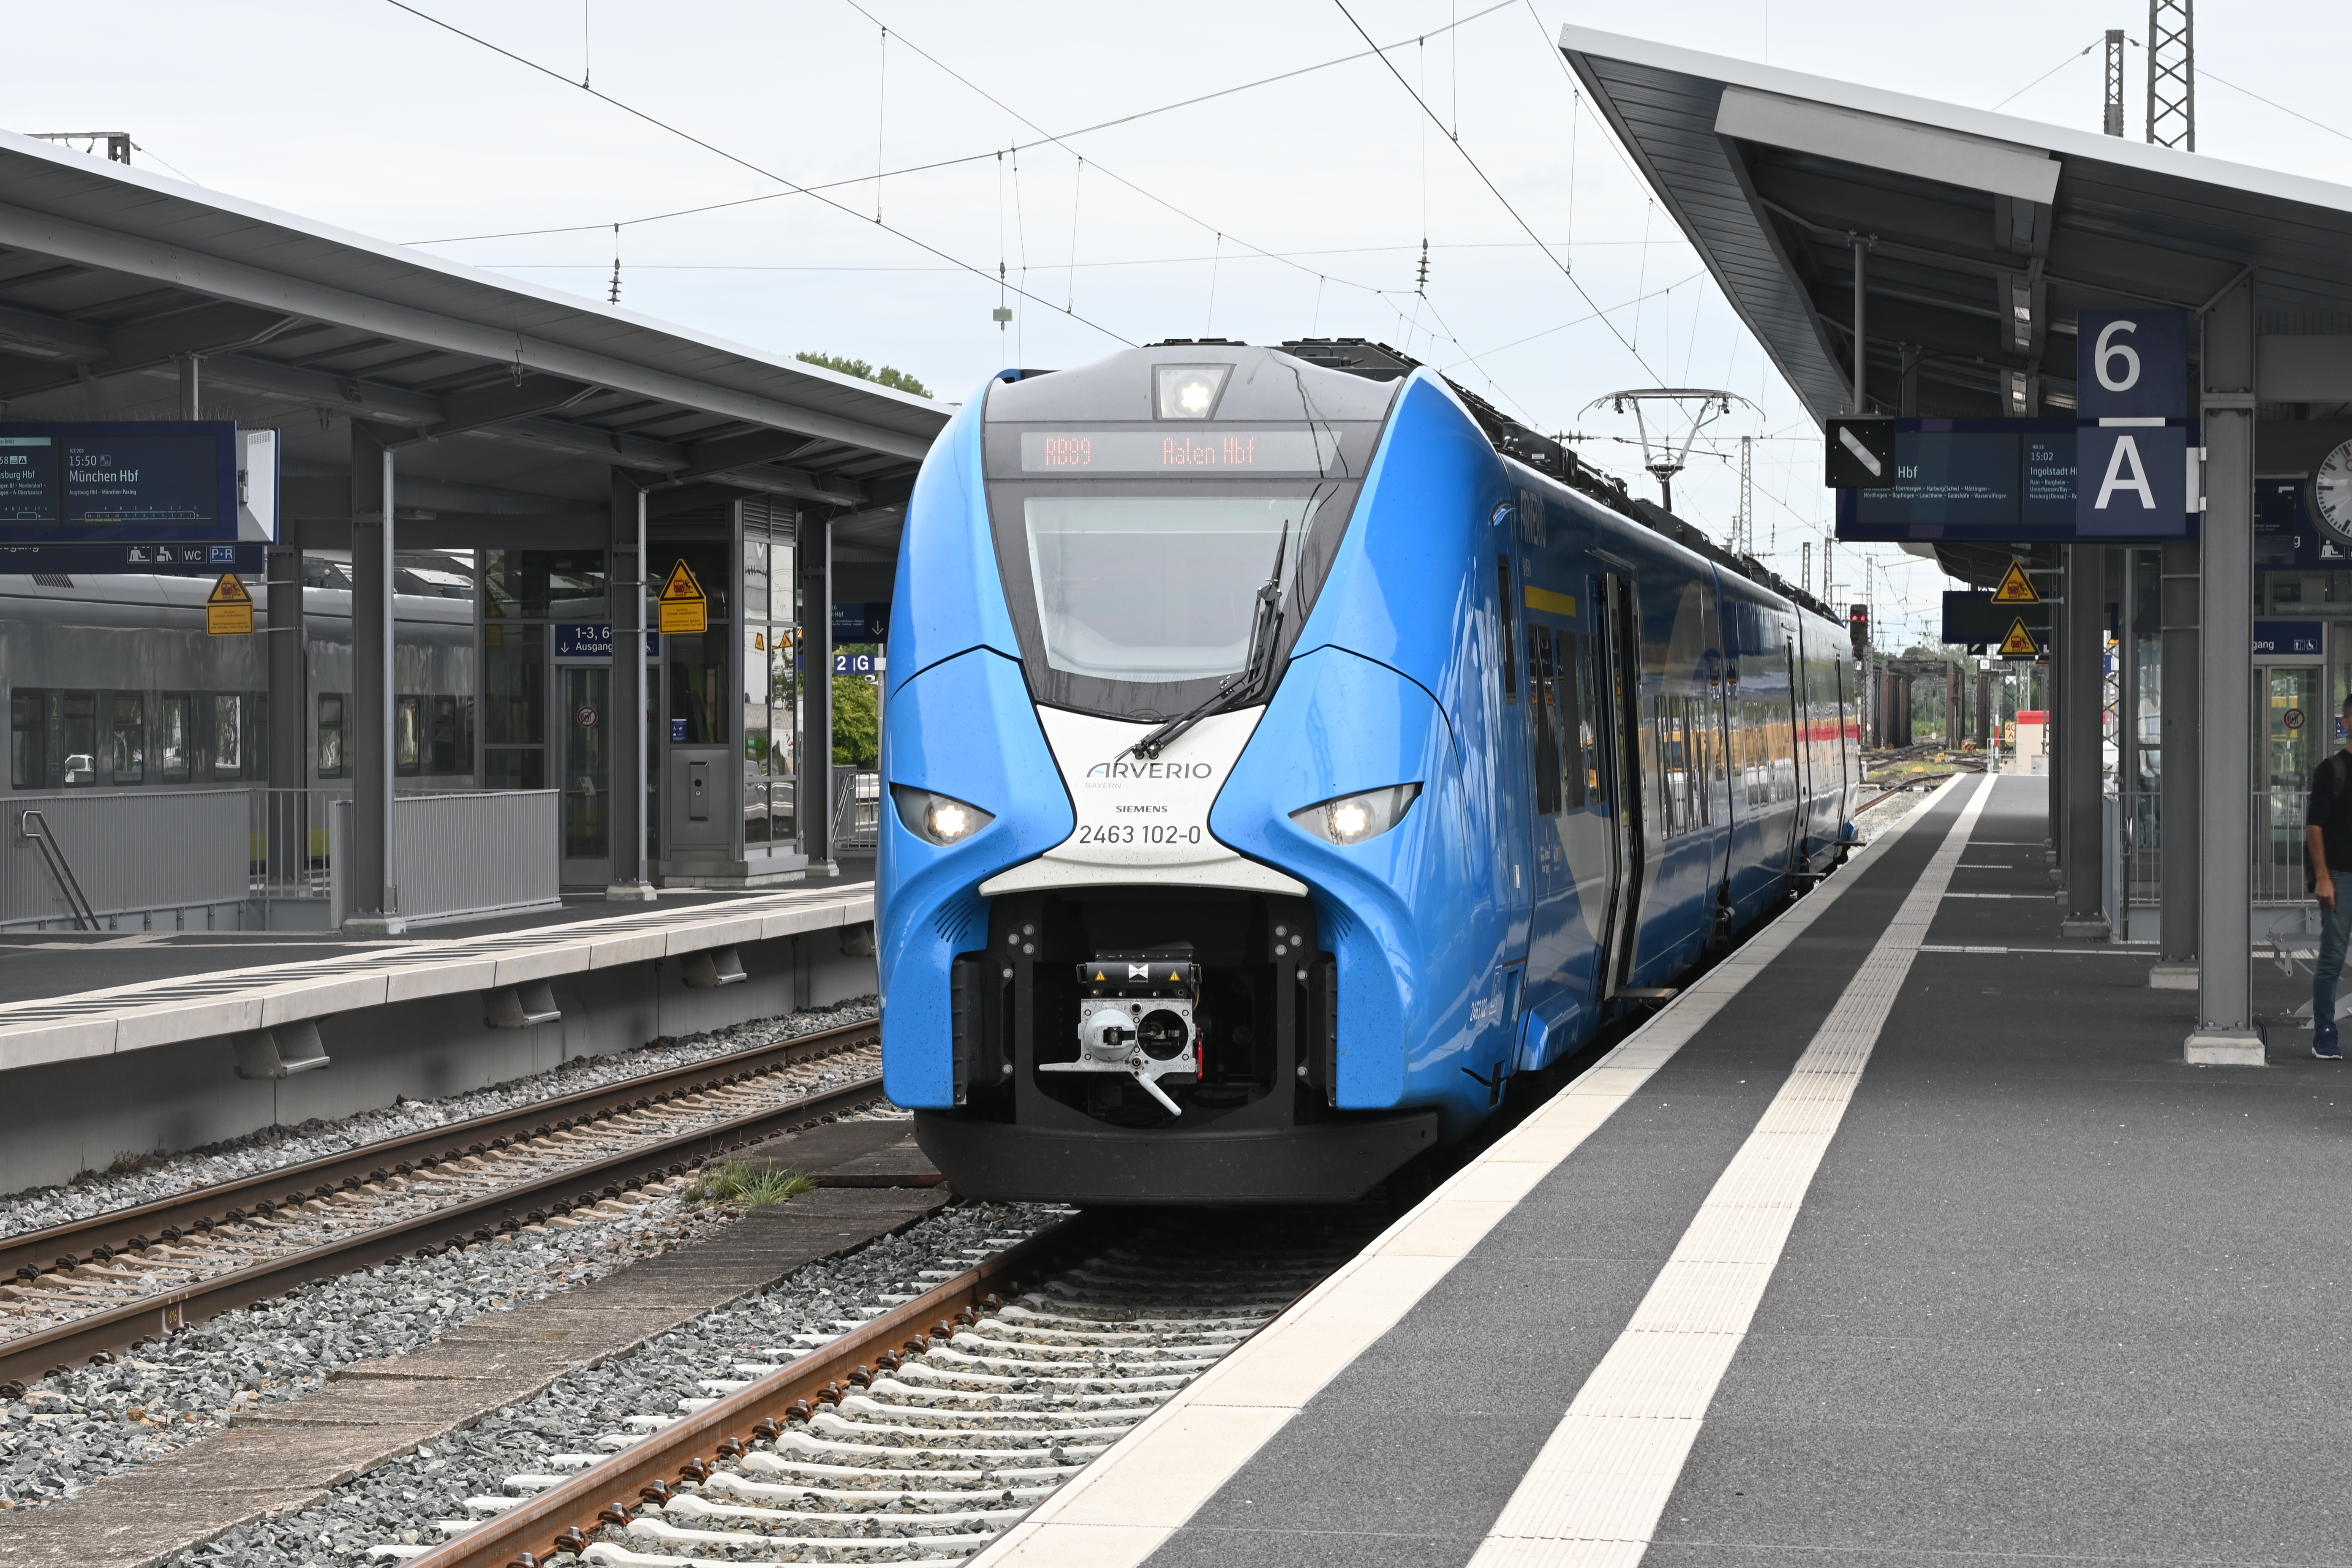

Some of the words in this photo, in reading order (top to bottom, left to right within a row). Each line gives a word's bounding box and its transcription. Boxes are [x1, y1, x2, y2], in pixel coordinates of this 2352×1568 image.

[2094, 320, 2140, 392] 6
[1163, 437, 1215, 465] Aalen
[1223, 437, 1255, 464] Hbf
[2031, 452, 2053, 461] 15:02
[69, 456, 97, 466] 15:50
[23, 470, 35, 479] Hbf
[69, 470, 117, 482] München
[120, 470, 139, 482] Hbf
[1898, 466, 1917, 478] Hbf
[2031, 466, 2068, 477] Ingolstadt
[2070, 467, 2077, 475] H
[2094, 435, 2156, 509] A
[1521, 490, 1546, 548] ARVERIO
[185, 551, 201, 560] WC
[576, 627, 597, 640] 1-3,
[837, 656, 846, 671] 2
[857, 655, 868, 670] G
[53, 697, 57, 716] 2
[1086, 763, 1212, 779] ARVERIO
[1080, 826, 1134, 844] 2463
[1142, 826, 1200, 844] 102-0
